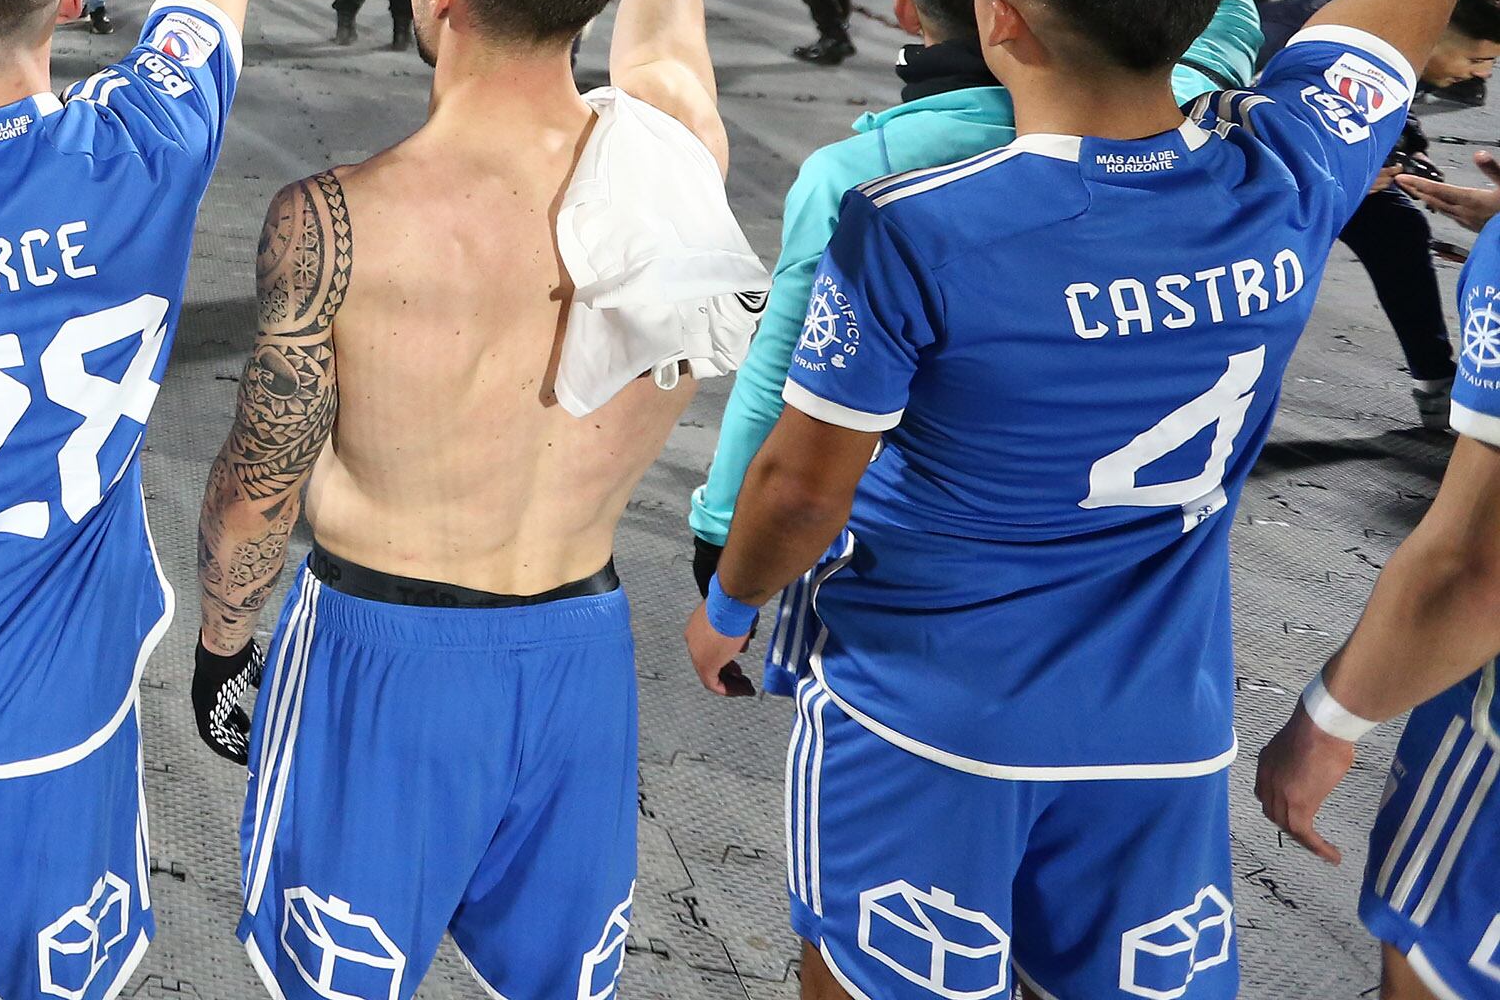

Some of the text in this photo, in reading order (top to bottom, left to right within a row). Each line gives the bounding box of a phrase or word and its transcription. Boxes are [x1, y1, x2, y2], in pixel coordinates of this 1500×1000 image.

[14, 113, 34, 128] DEL
[1095, 149, 1180, 167] MÁS ALLÁ DEL
[1105, 160, 1174, 174] HORIZONTE
[824, 275, 860, 357] PACIFIC'S
[1064, 247, 1305, 339] CASTRO
[1077, 344, 1266, 534] 4
